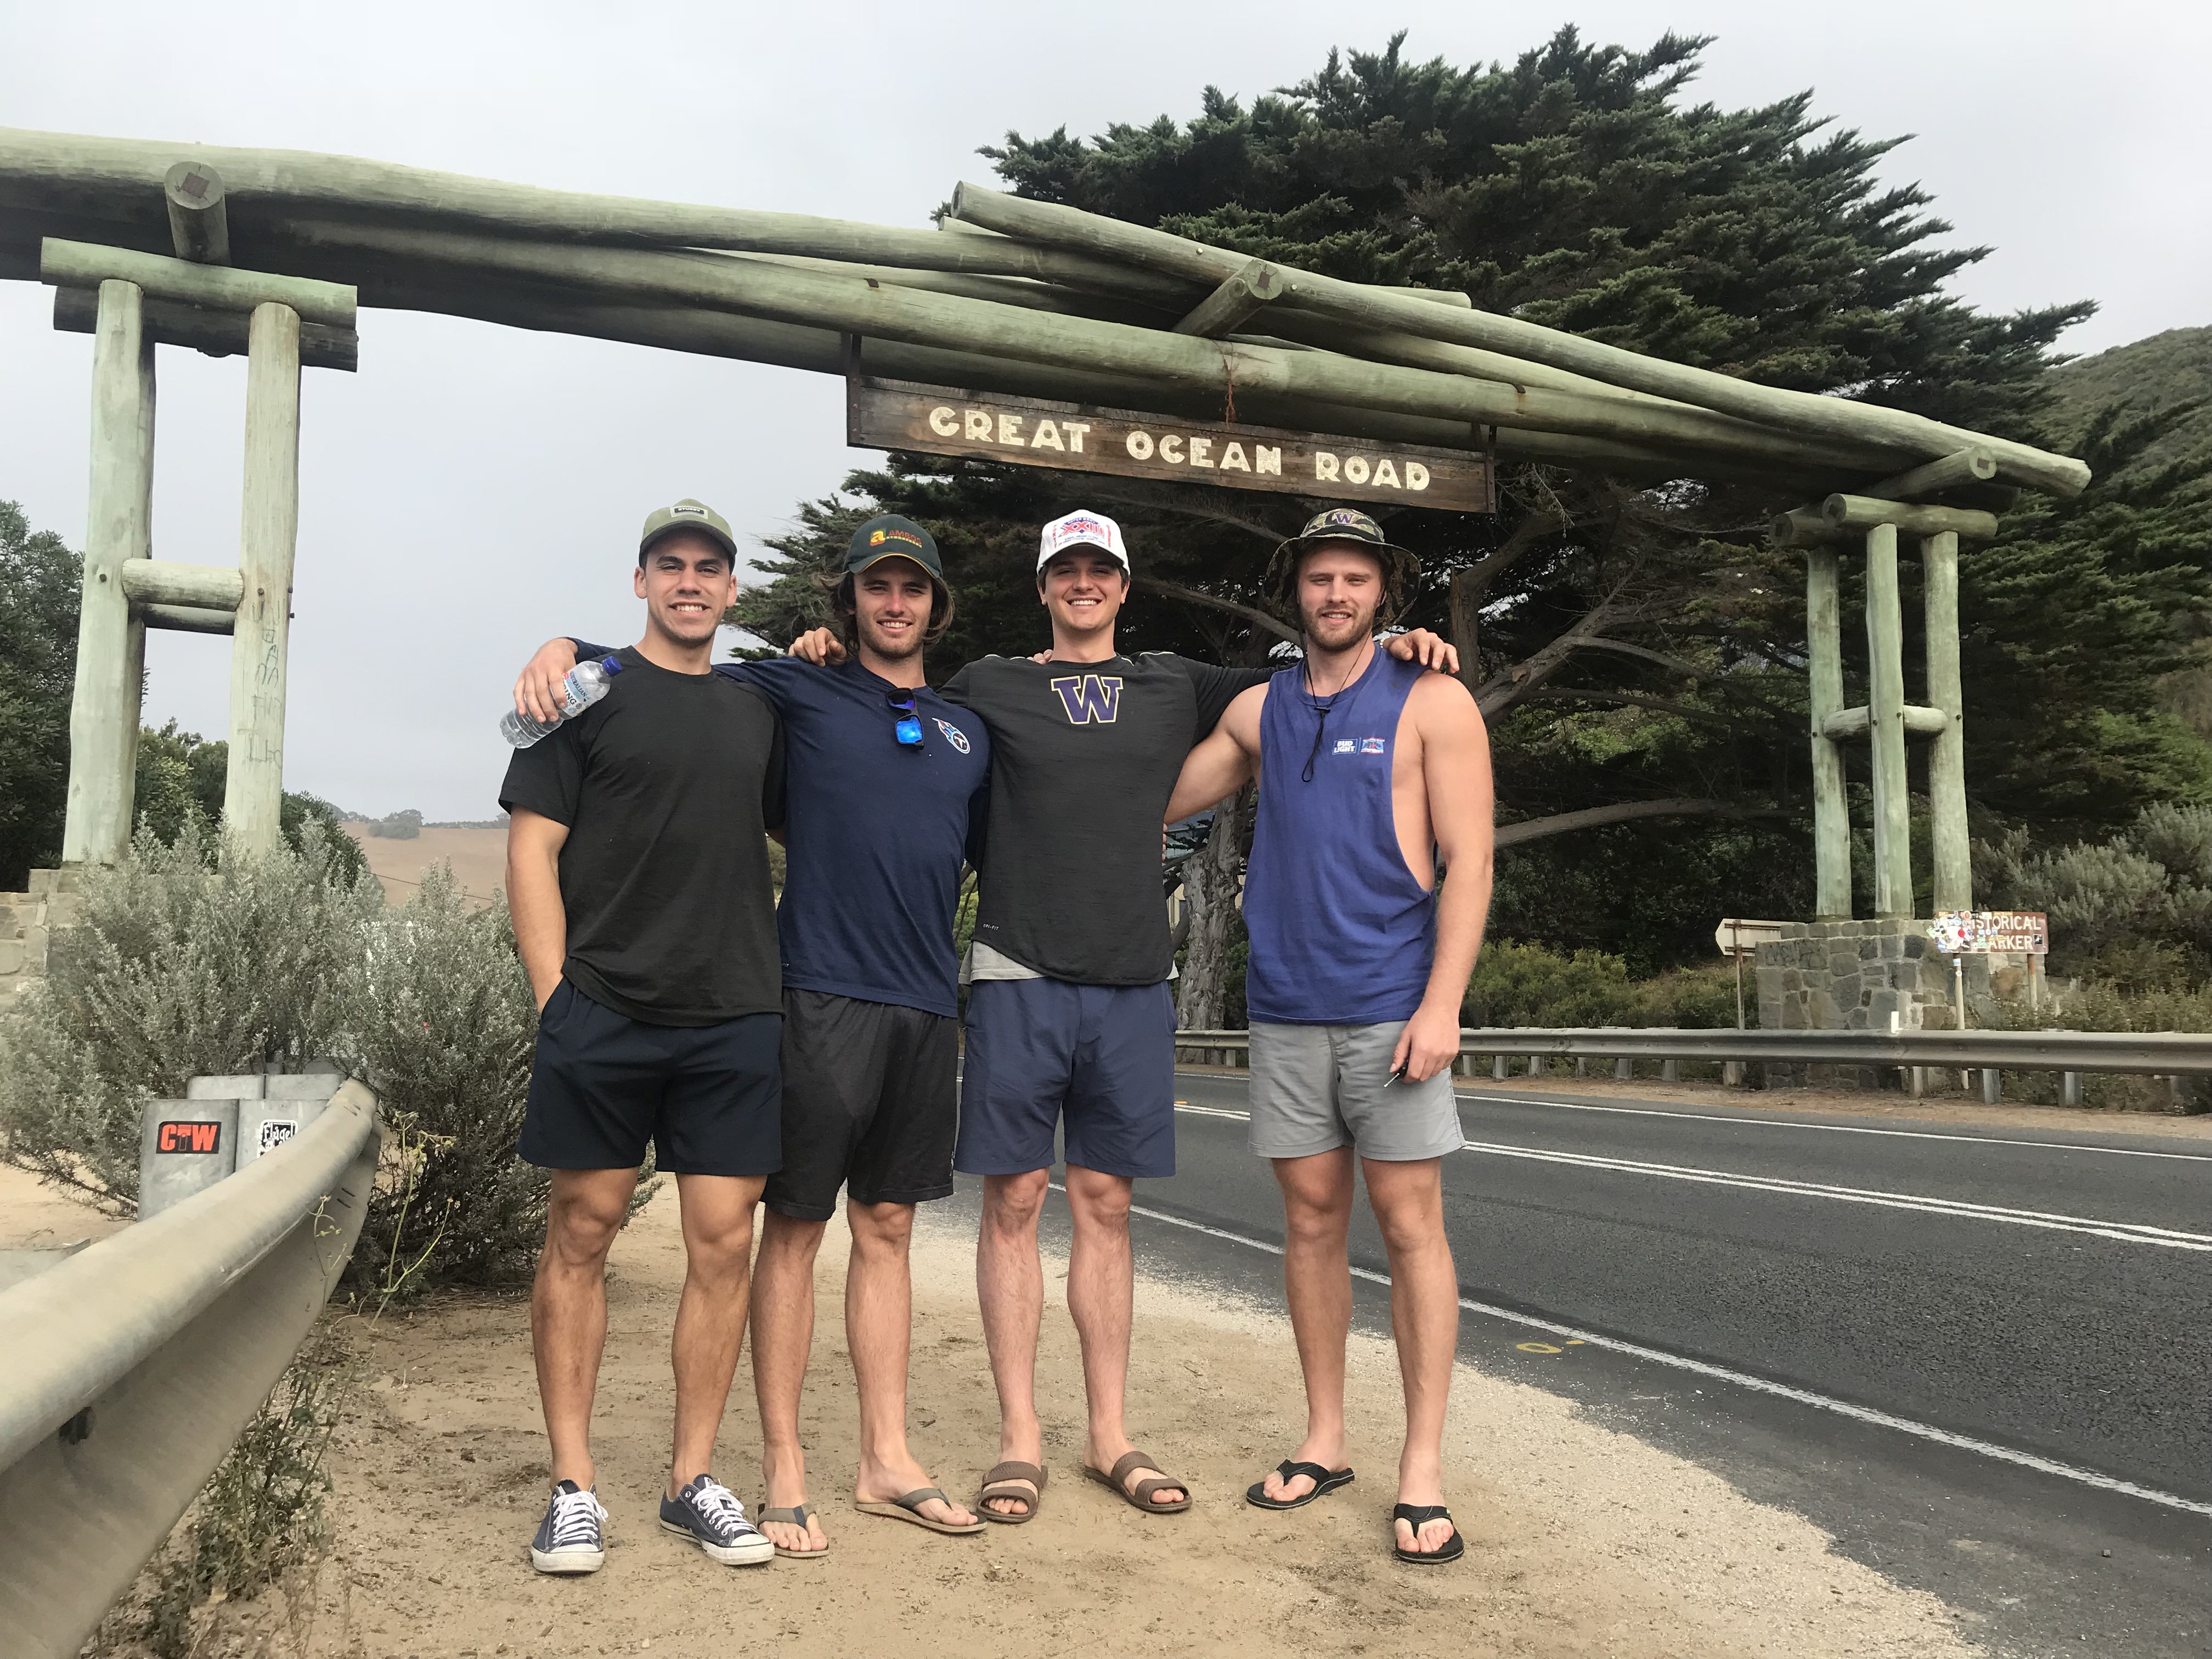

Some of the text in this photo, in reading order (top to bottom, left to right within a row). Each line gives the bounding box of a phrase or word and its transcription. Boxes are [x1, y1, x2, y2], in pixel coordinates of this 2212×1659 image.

[929, 407, 1430, 490] GREAT OCEAN ROAD
[1335, 512, 1355, 524] W
[1060, 521, 1104, 537] XXIII
[1050, 674, 1124, 724] W
[1970, 915, 2041, 930] ISTORICAL
[1985, 935, 2033, 950] ARKER
